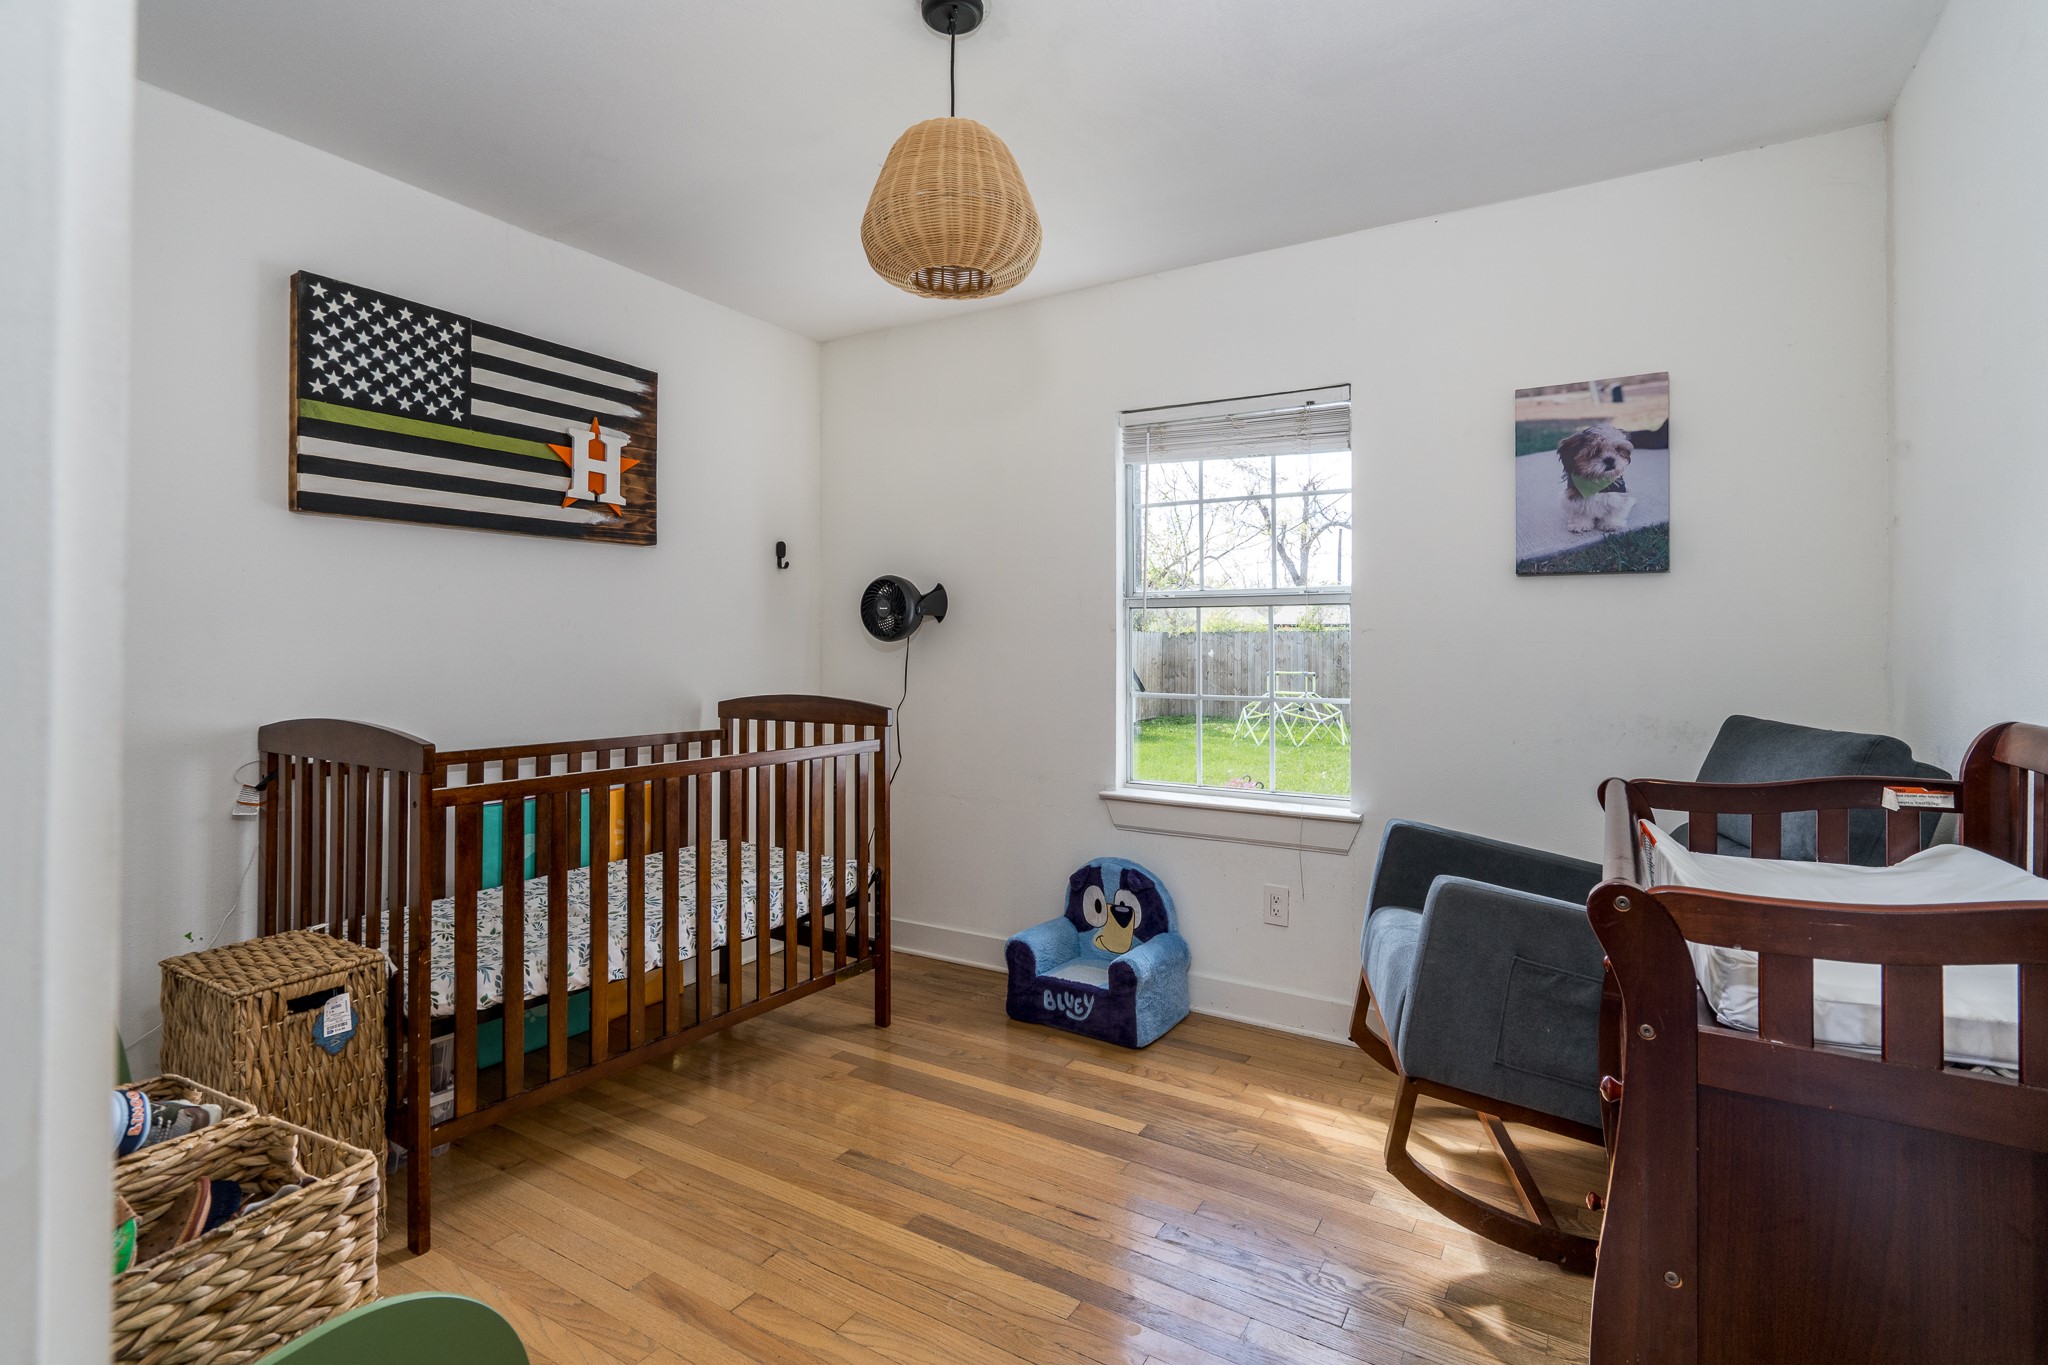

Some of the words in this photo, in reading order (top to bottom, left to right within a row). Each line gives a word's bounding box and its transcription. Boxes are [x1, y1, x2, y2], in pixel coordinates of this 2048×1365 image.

[566, 427, 629, 506] H
[1043, 989, 1095, 1021] BLUEY
[126, 1090, 145, 1137] BINGO
